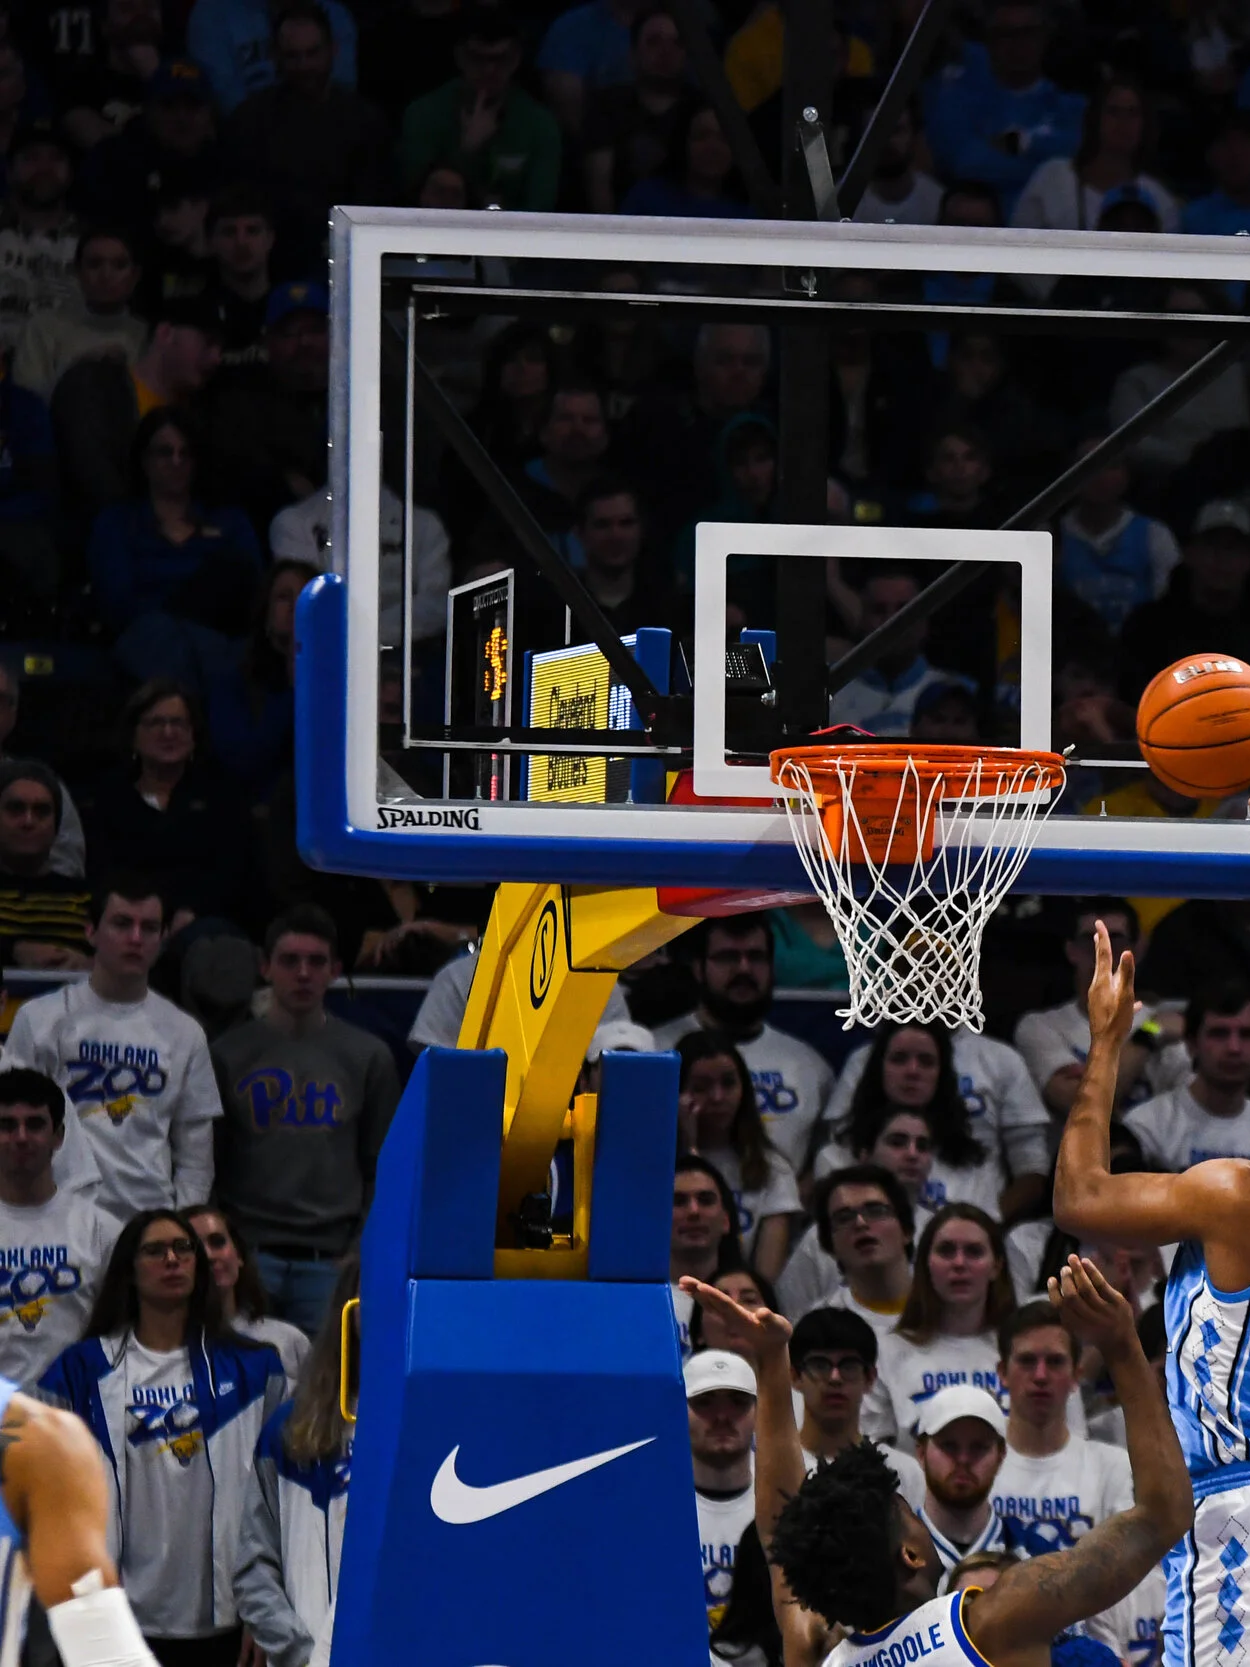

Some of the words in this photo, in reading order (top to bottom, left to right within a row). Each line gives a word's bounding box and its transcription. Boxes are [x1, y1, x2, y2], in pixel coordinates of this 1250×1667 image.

[377, 806, 482, 831] SPALDING
[79, 1040, 158, 1069] OAKLAND
[65, 1060, 168, 1105] ZOO
[236, 1066, 345, 1132] Pitt
[0, 1246, 68, 1270] AKLAND
[132, 1384, 194, 1405] OAKLA
[125, 1400, 201, 1448] ZO
[992, 1496, 1080, 1519] OAKLAND
